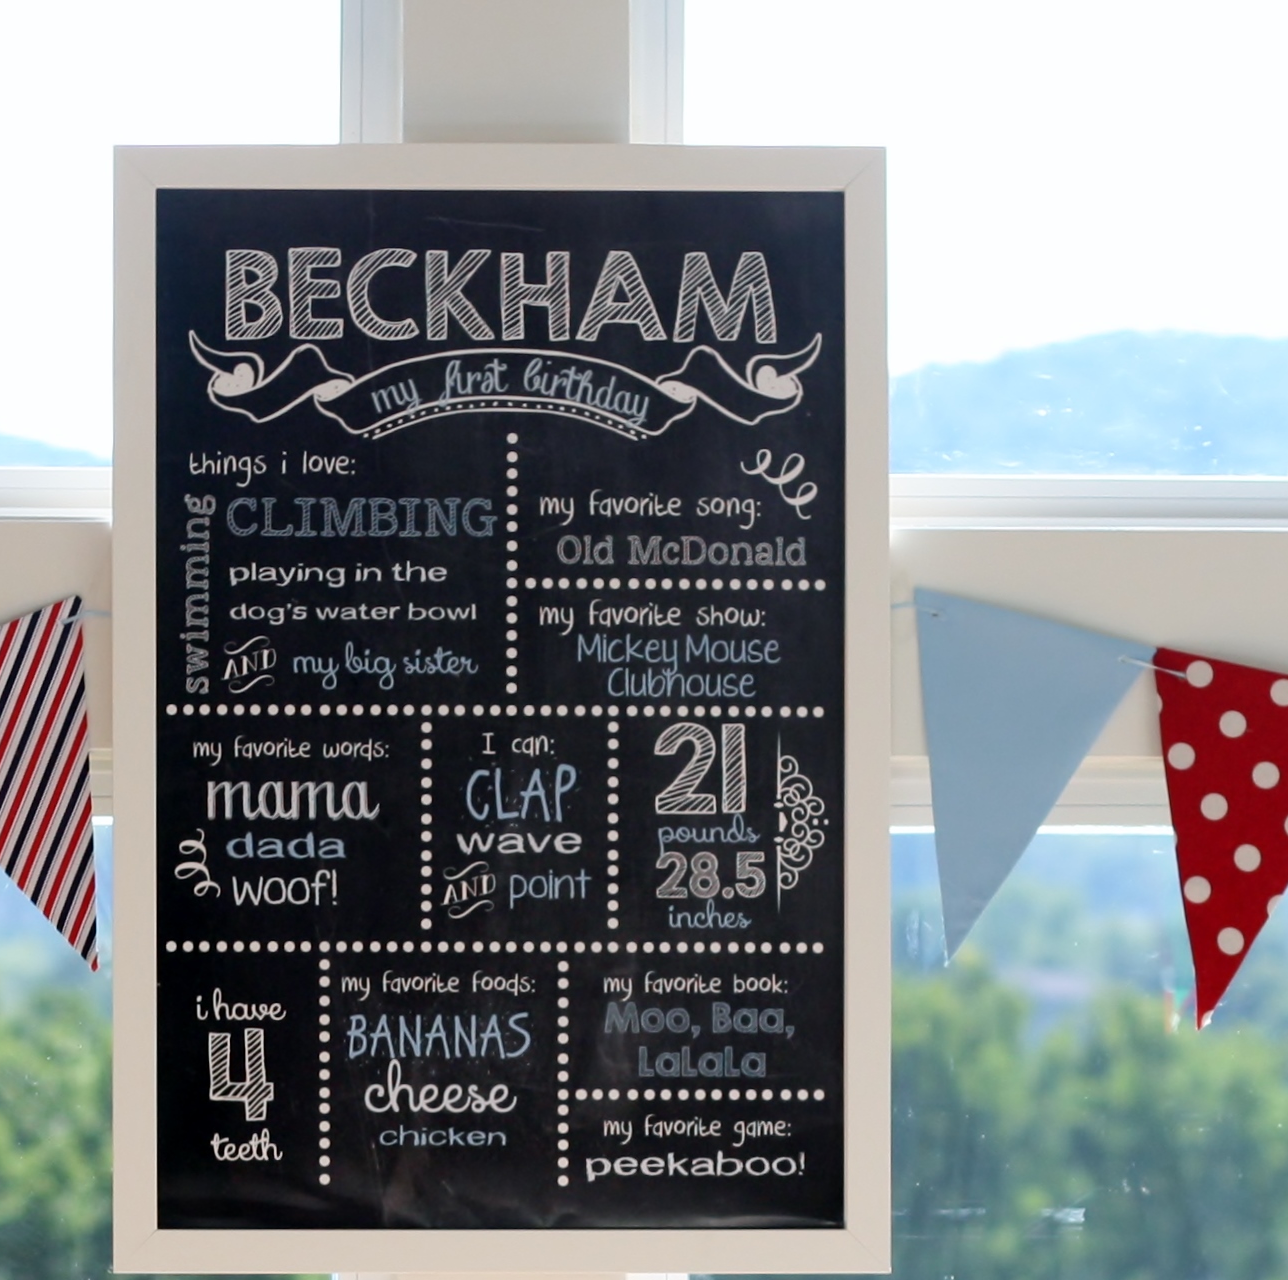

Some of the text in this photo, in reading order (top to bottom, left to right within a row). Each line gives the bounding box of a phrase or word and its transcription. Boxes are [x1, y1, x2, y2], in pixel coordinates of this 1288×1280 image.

[225, 247, 777, 344] BECKHAM
[370, 356, 649, 428] my first birthday
[189, 451, 356, 487] things i love:
[226, 497, 498, 537] CLIMBING
[539, 489, 761, 529] my favorite song:
[557, 535, 807, 566] Old McDonald
[230, 561, 447, 587] playing in the
[180, 493, 216, 694] swimming
[230, 603, 477, 625] dog's water bowl
[539, 599, 766, 635] my favorite show:
[221, 641, 479, 690] AND my big sister
[577, 633, 781, 675] Mickey Mouse
[607, 667, 756, 698] Clubhouse
[193, 735, 390, 767] my favorite words:
[482, 732, 555, 757] I can:
[654, 722, 746, 814] 21
[206, 780, 380, 820] mama
[466, 764, 577, 822] CLAP
[226, 832, 347, 859] dada
[456, 832, 582, 854] wave
[657, 814, 760, 856] pounds
[232, 869, 338, 906] woof!
[440, 869, 592, 909] AND point
[656, 852, 766, 899] 28.5
[668, 899, 752, 930] inches
[341, 970, 536, 1001] my favorite foods:
[603, 971, 789, 1001] my favorite book:
[196, 988, 286, 1021] i have
[604, 1001, 795, 1039] Moo, Baa,
[347, 1012, 532, 1060] BANANAS
[209, 1028, 274, 1121] 4
[638, 1046, 766, 1077] LaLaLa
[364, 1059, 517, 1113] cheese
[210, 1128, 283, 1161] teeth
[379, 1125, 507, 1146] chicken
[603, 1114, 791, 1148] my favorite game:
[586, 1150, 806, 1182] peekaboo!
